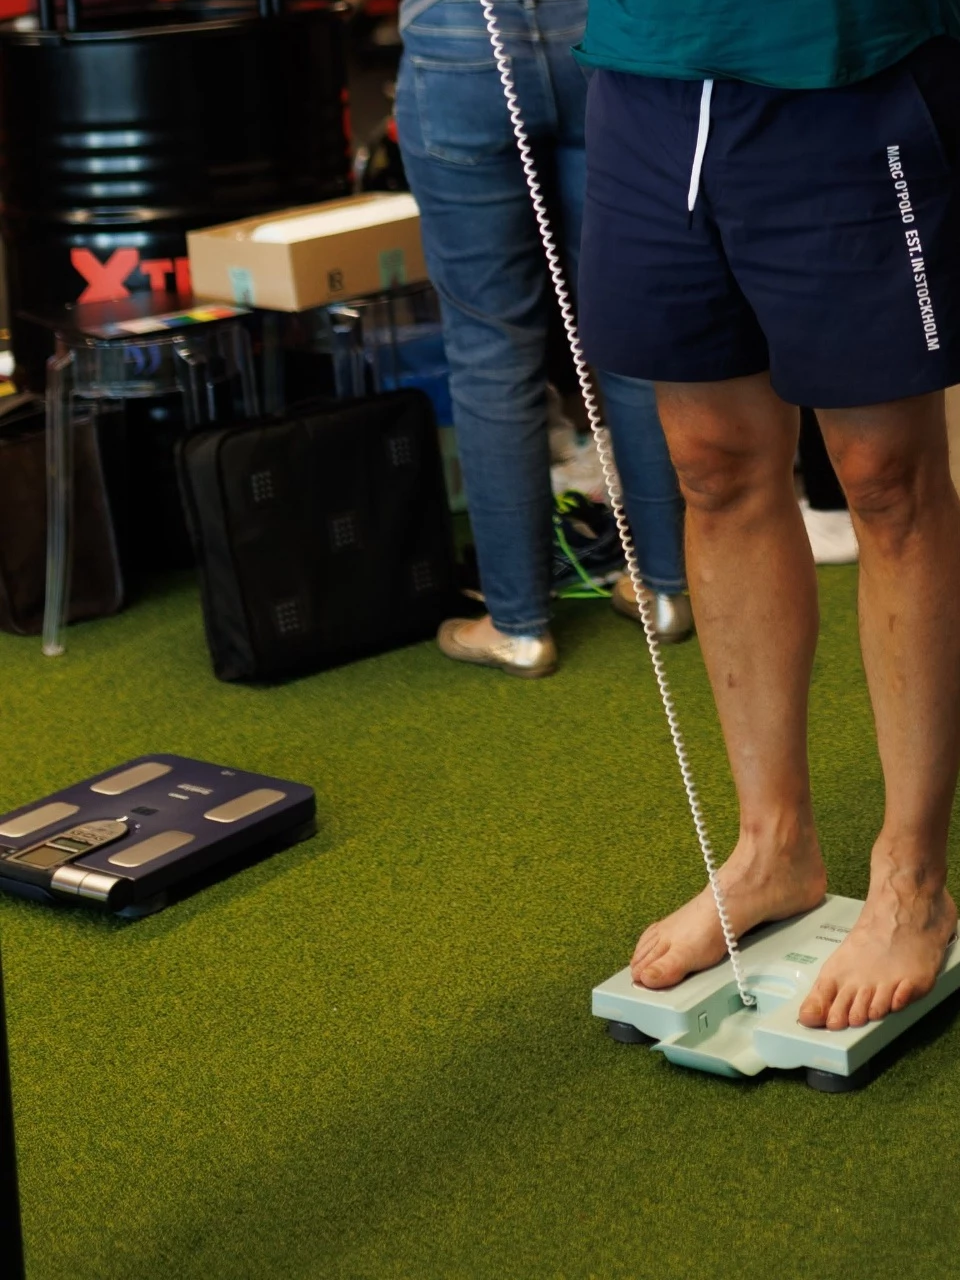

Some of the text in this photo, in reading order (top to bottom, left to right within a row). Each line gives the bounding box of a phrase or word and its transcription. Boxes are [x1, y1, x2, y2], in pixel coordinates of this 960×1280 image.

[886, 145, 940, 351] MARC O'POLO EST. IN STOCKHOLM
